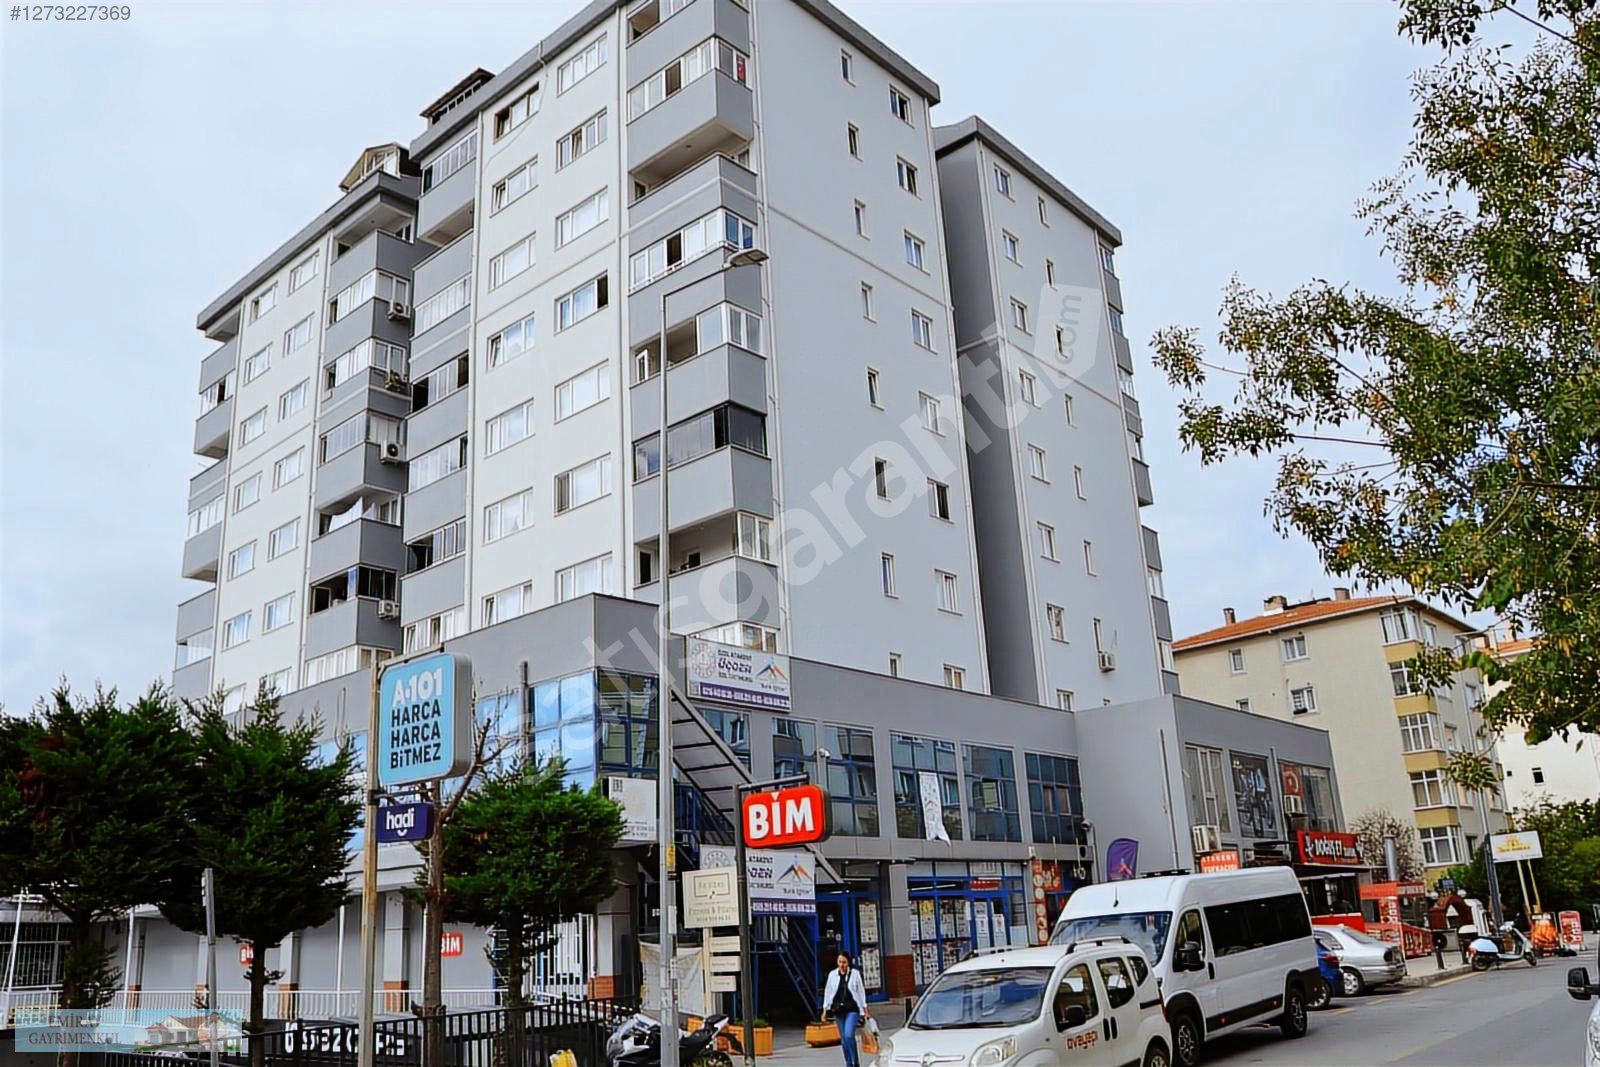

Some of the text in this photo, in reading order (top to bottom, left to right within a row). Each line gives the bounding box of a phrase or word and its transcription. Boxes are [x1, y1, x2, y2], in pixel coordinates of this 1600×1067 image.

[391, 699, 441, 727] HARCA
[391, 721, 441, 749] HARCA
[386, 807, 415, 831] hadi
[748, 791, 815, 840] BİM
